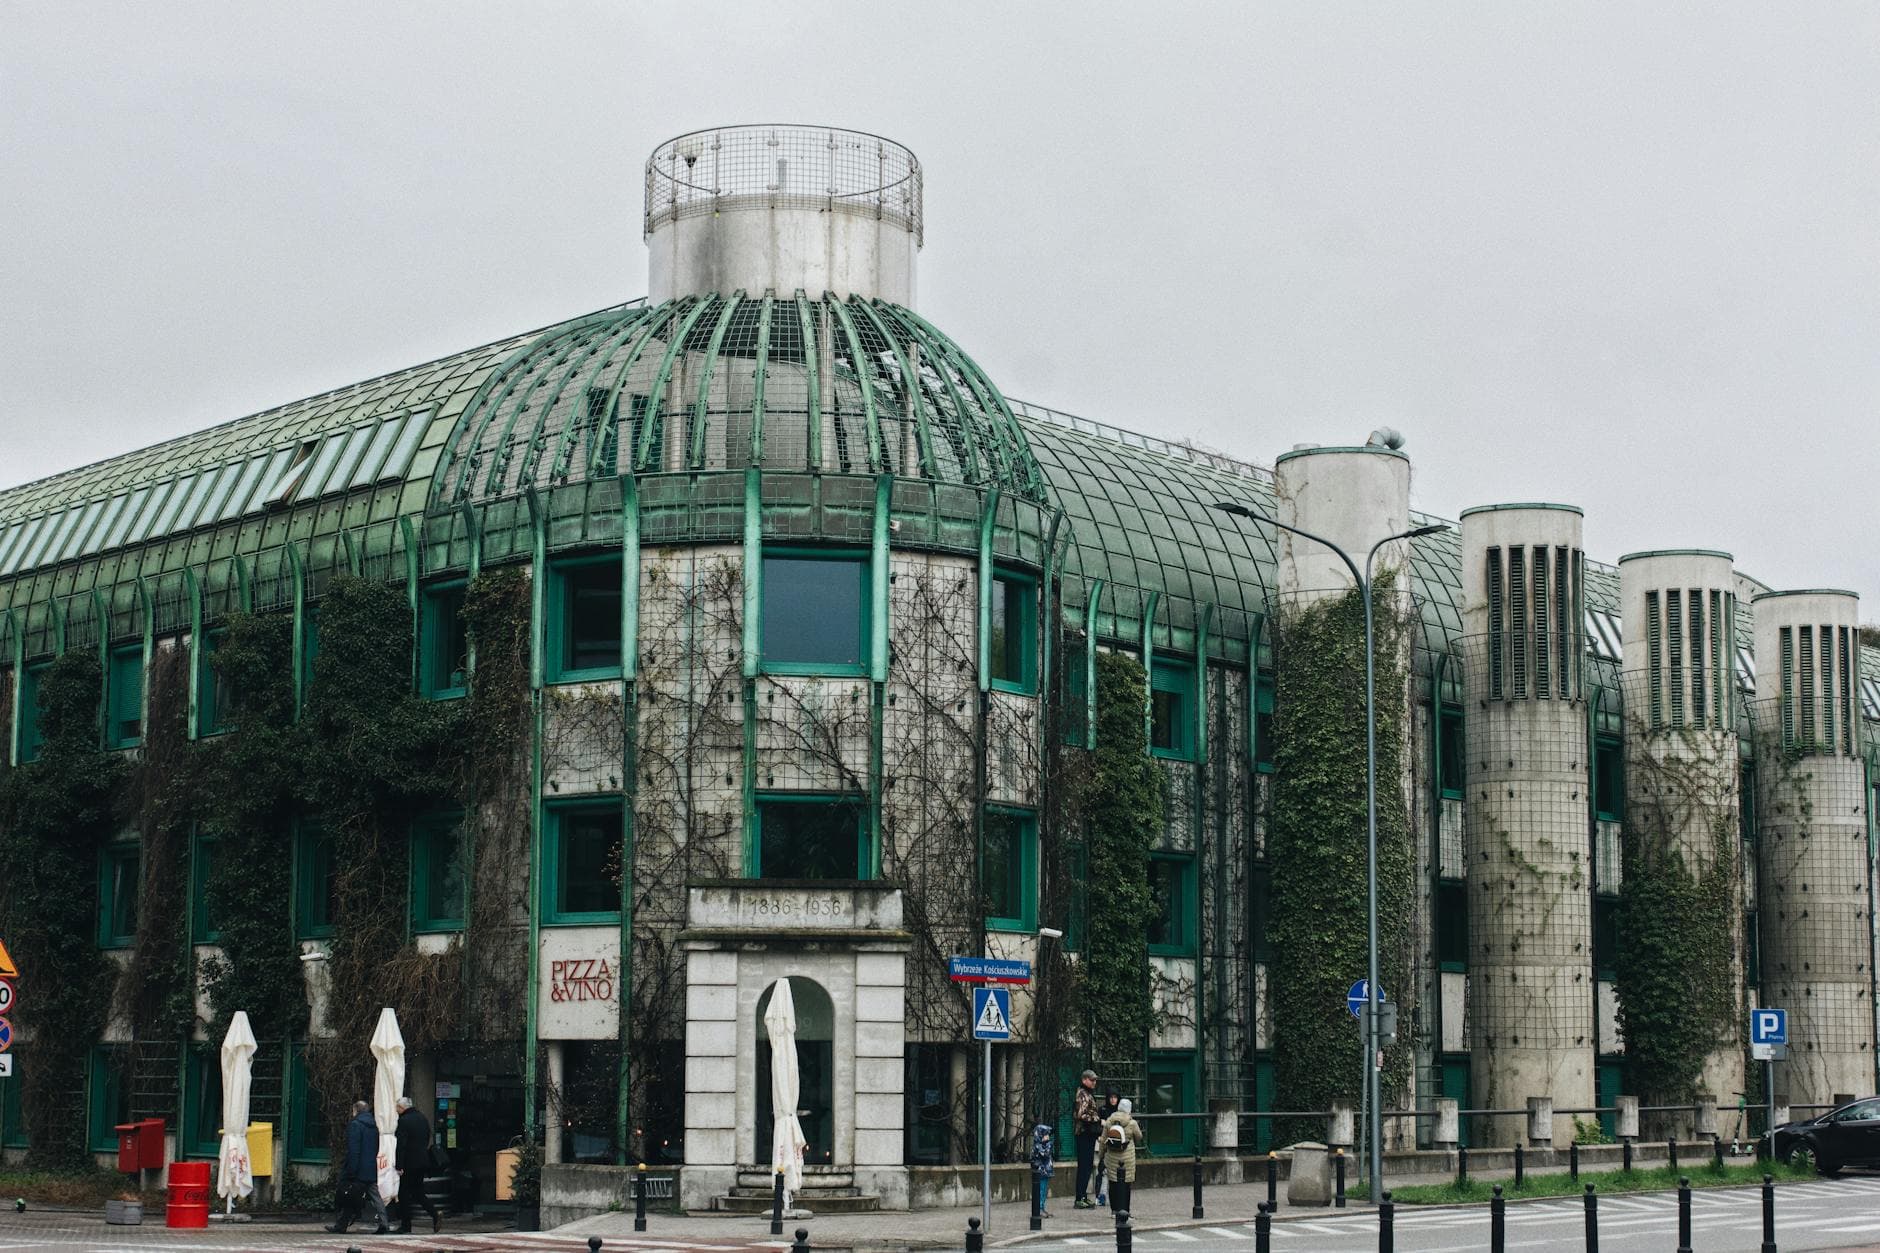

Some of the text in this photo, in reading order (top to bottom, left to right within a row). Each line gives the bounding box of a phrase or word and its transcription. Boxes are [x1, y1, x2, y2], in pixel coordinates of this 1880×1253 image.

[751, 899, 841, 915] 1886-1936
[552, 959, 612, 981] PIZZA
[953, 963, 1028, 977] Wybrzeże Kościuszkowskie
[1760, 1013, 1779, 1040] P
